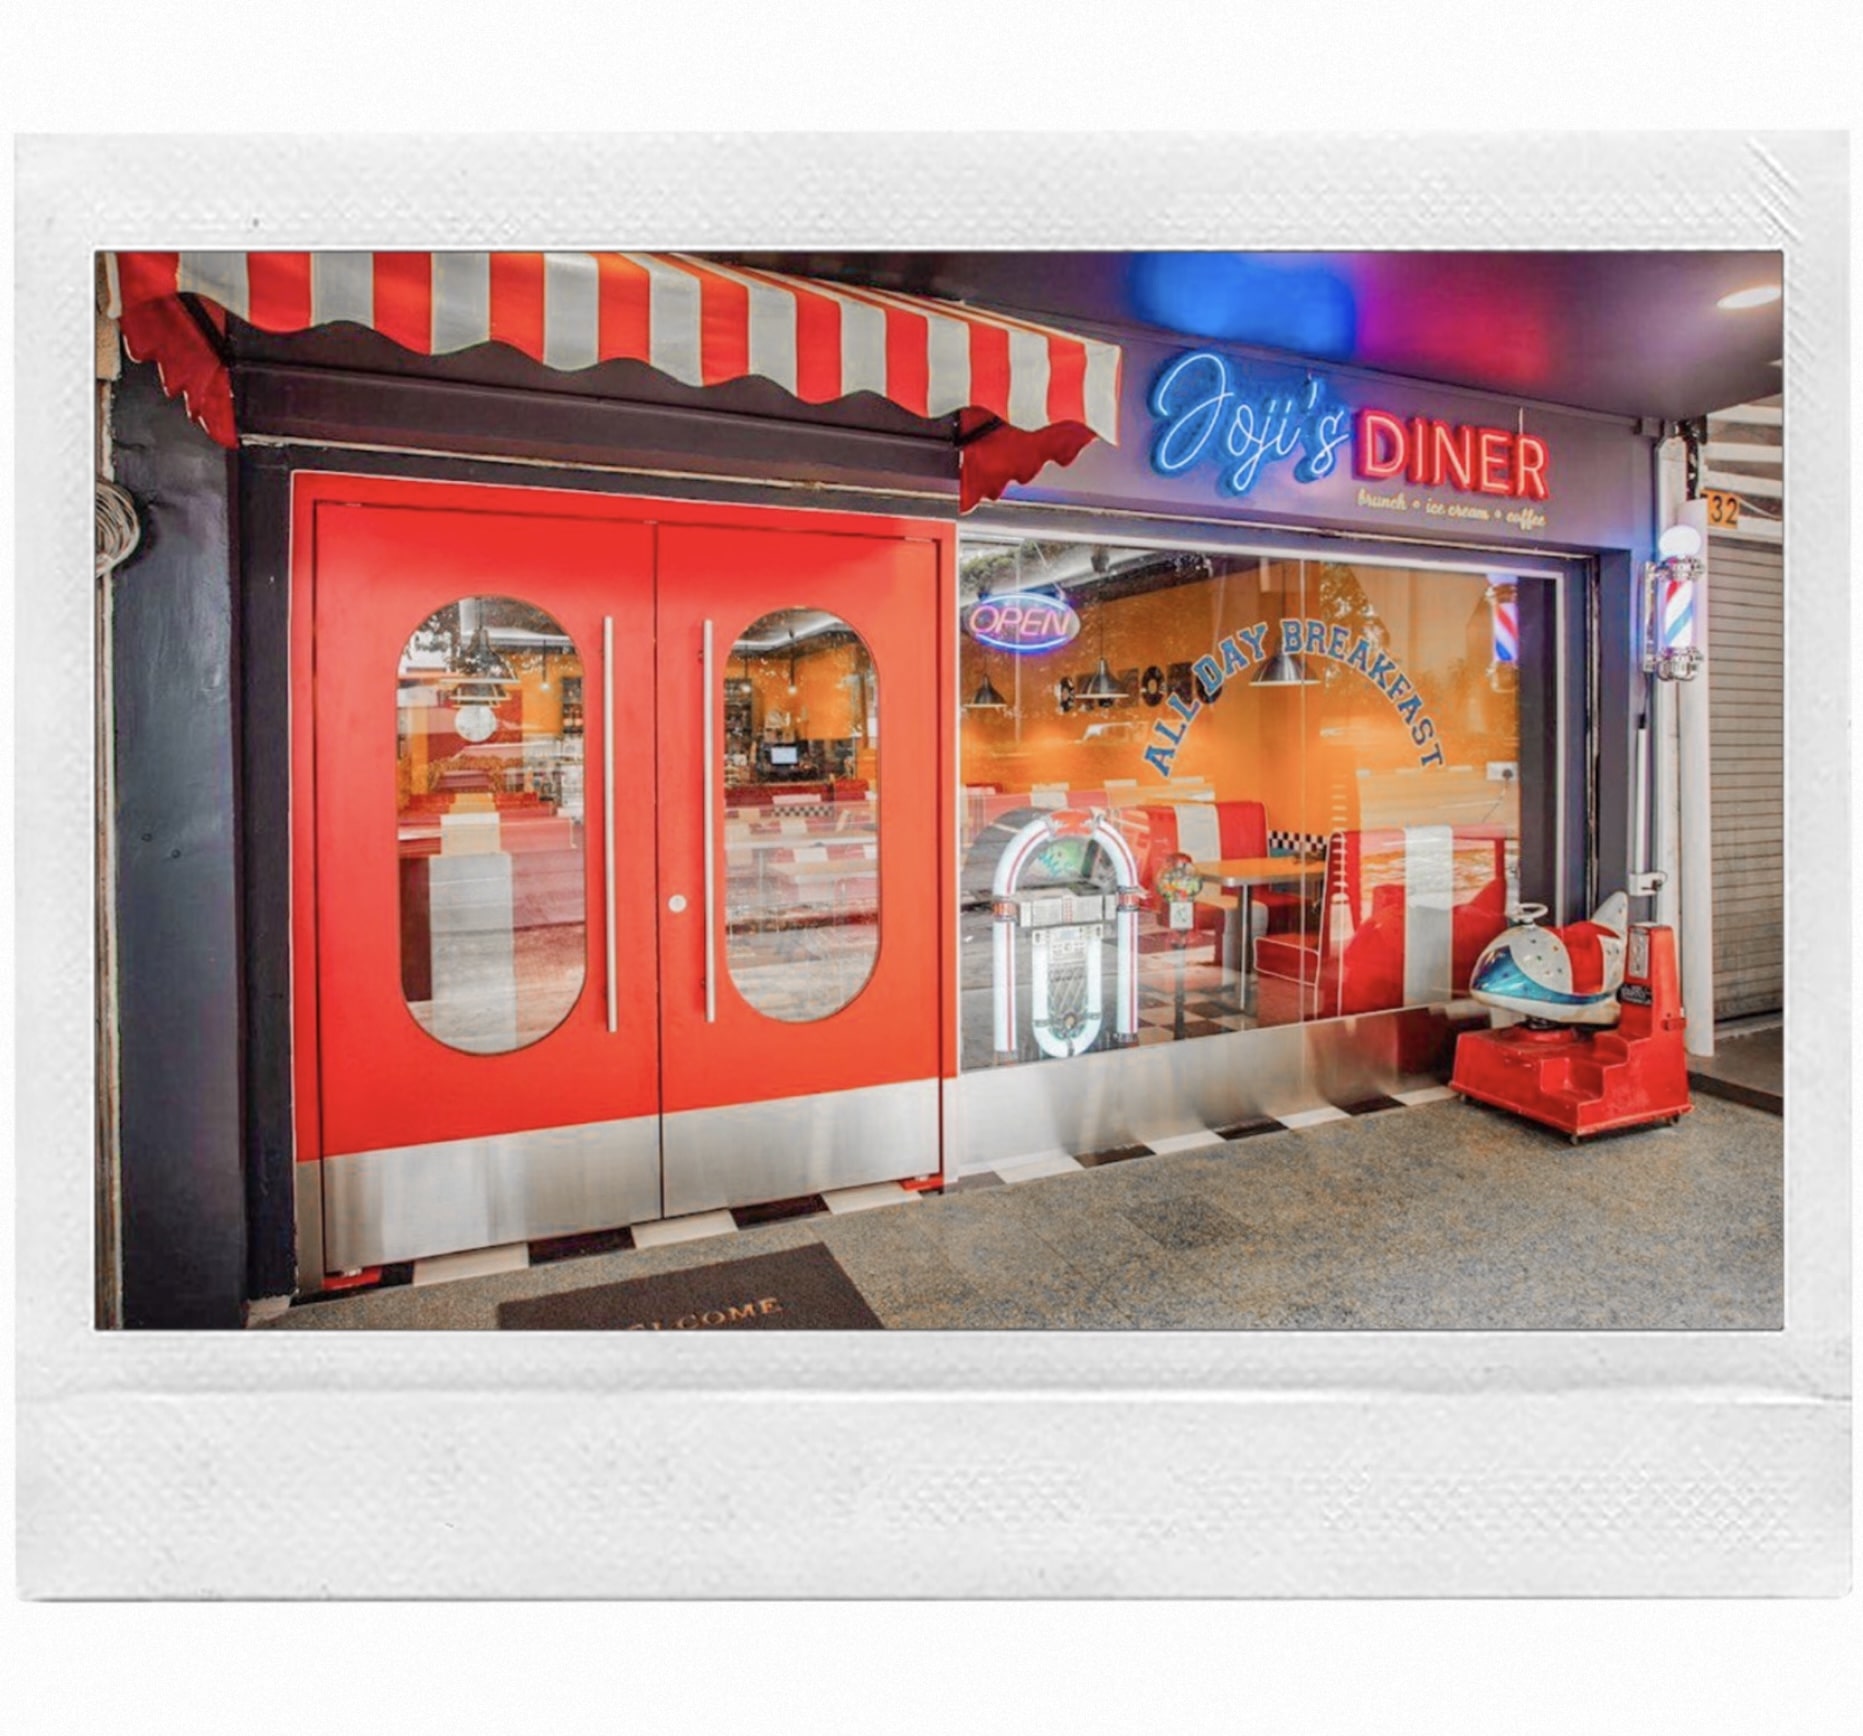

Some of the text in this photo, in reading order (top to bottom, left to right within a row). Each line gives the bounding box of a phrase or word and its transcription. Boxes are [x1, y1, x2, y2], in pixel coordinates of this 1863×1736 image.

[1154, 350, 1548, 500] Joji's DINER
[1357, 487, 1547, 531] brunch ice cream coffee
[1700, 493, 1737, 525] 32
[968, 606, 1072, 639] OPEN
[1144, 618, 1446, 778] ALL DAY BREAKFAST
[628, 1297, 784, 1330] COME
